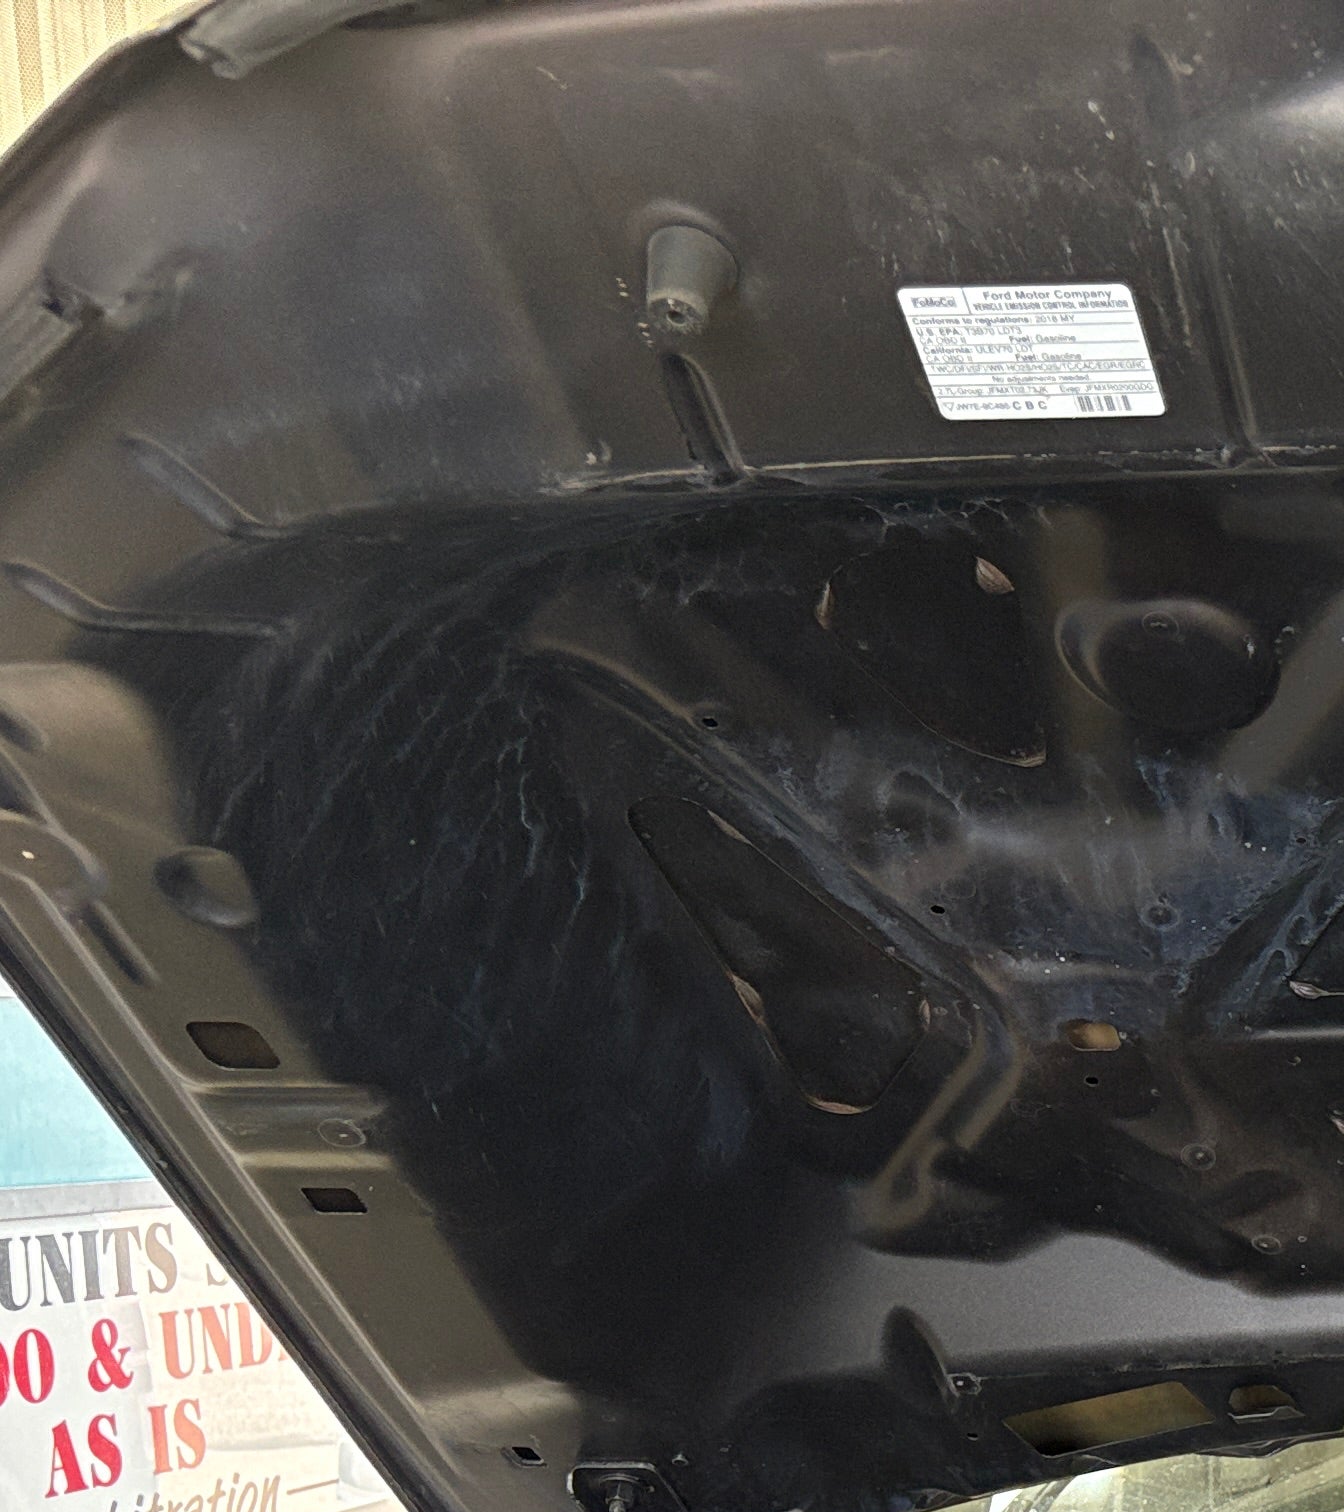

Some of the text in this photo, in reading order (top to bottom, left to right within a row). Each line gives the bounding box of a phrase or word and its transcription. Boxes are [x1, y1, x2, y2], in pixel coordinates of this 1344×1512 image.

[911, 296, 957, 308] FoMoCo
[911, 316, 960, 326] Conforms
[962, 316, 973, 325] to
[982, 289, 1112, 302] Ford Motor Company
[0, 1222, 178, 1311] UNITS
[0, 1302, 289, 1407] 0 & UND
[45, 1398, 207, 1499] AS IS
